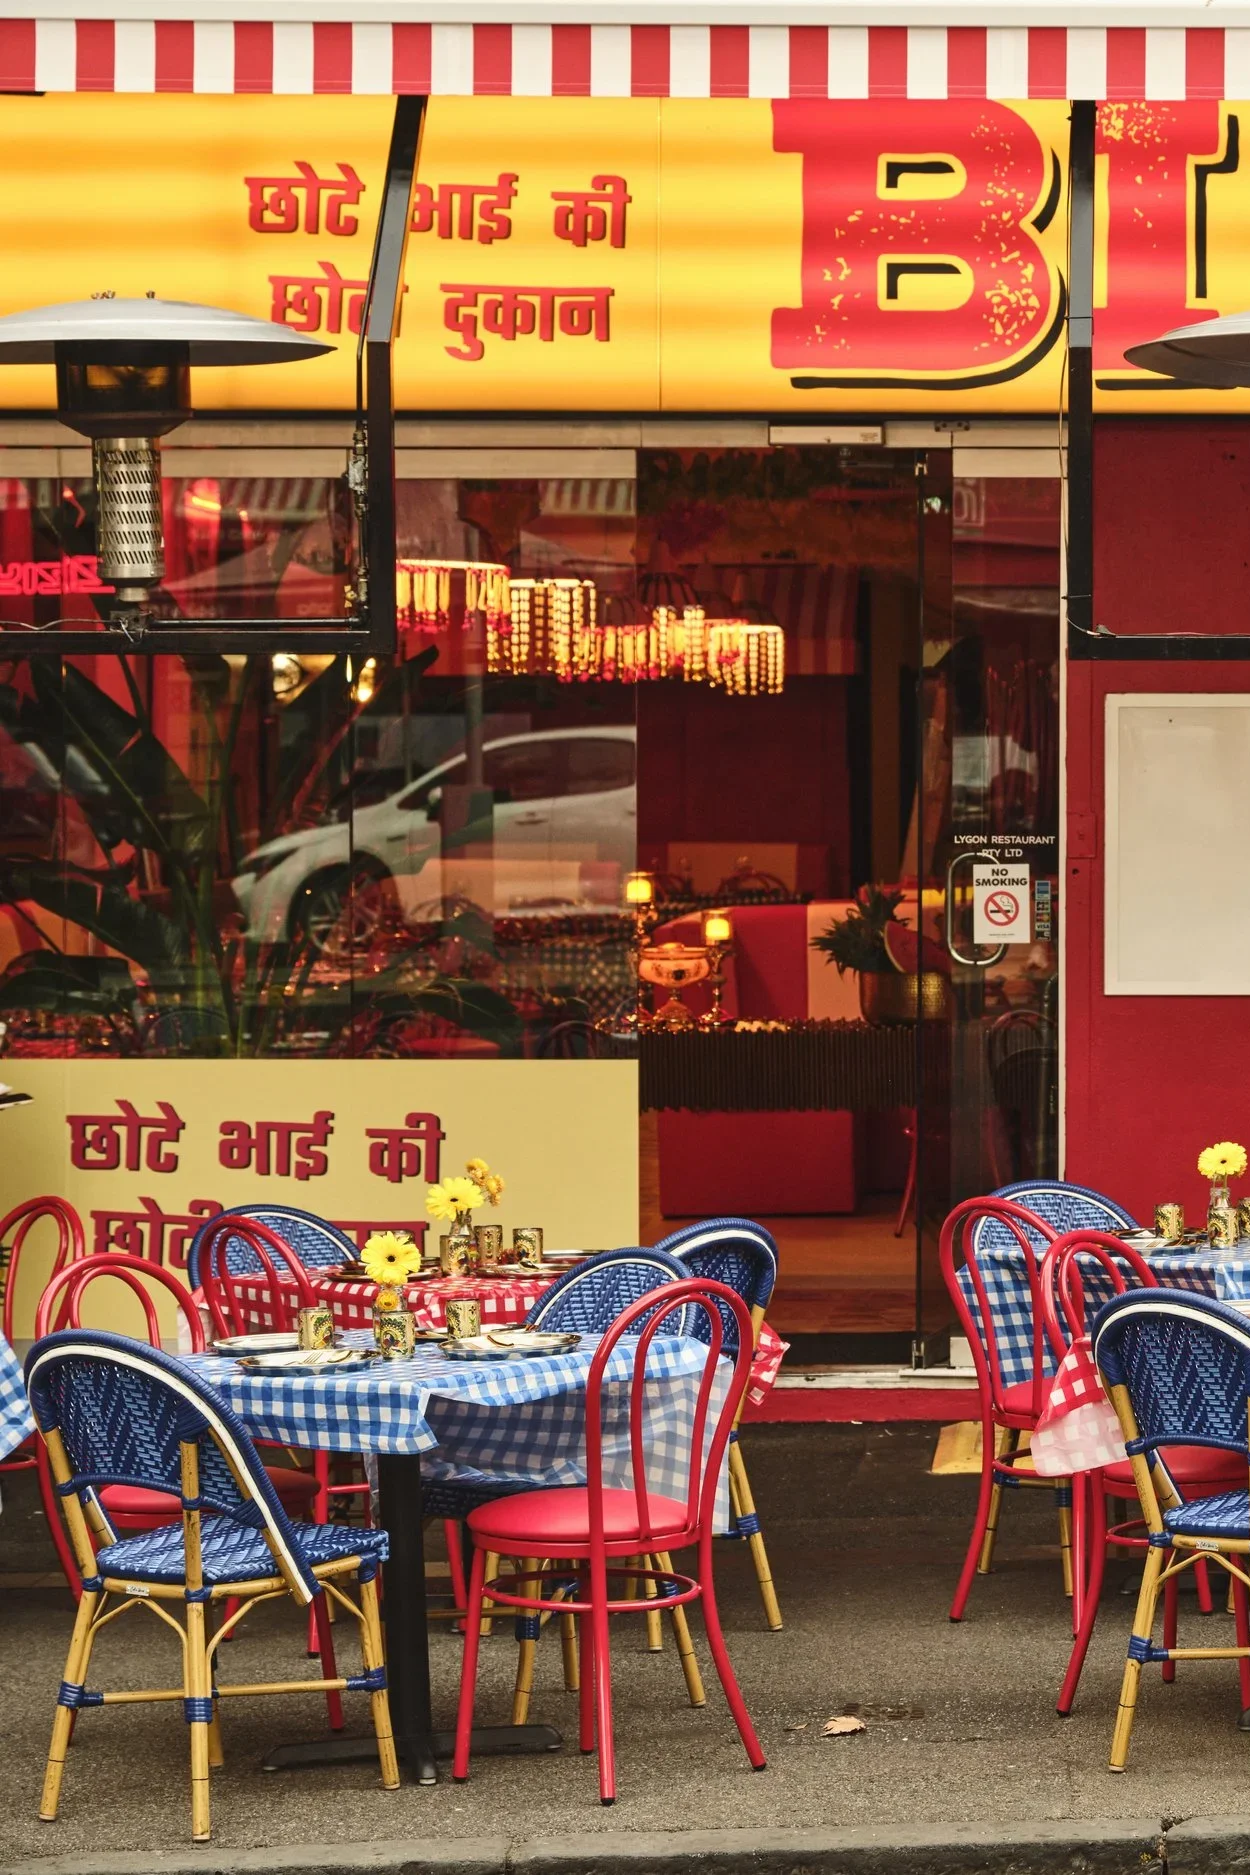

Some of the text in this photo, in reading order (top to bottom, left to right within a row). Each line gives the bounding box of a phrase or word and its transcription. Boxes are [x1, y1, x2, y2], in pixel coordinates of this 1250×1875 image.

[244, 161, 632, 248] छोटे भाई की
[268, 261, 615, 361] छोट दुकान
[954, 835, 1055, 844] LYGON RESTAURANT
[981, 848, 1023, 857] PTY LTD
[991, 868, 1008, 876] NO
[975, 878, 1027, 887] SMOKING
[66, 1099, 446, 1184] छोटे भाई की
